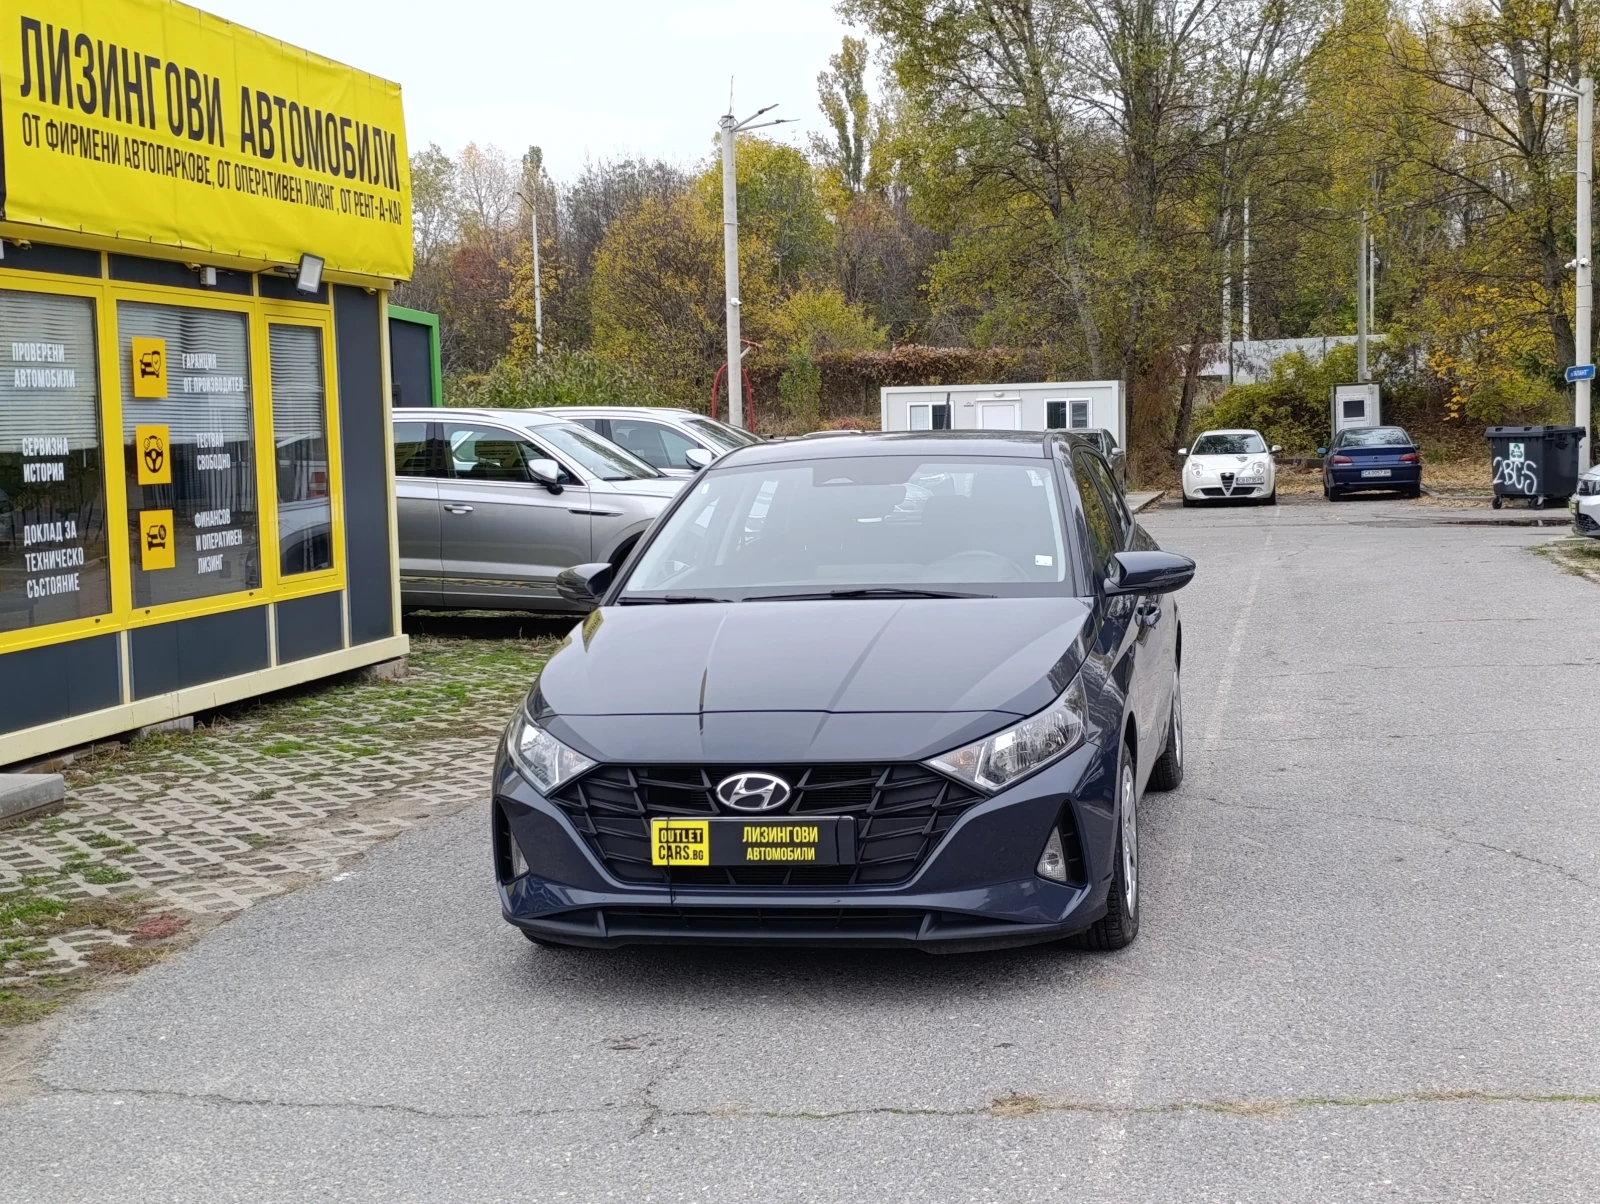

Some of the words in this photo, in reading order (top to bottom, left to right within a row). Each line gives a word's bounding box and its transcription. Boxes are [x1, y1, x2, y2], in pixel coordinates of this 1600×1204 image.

[20, 15, 225, 148] ЛИЗИНГОВИ
[240, 86, 401, 192] АВТОМОБИЛИ
[22, 112, 41, 149] ОТ
[45, 118, 121, 165] ФИРМЕНИ
[124, 136, 215, 190] АВТОПАРКОВЕ,
[217, 159, 231, 190] ОТ
[234, 163, 303, 205] ОПЕРАТИВЕН
[340, 188, 352, 215] ОТ
[12, 342, 65, 362] ПРОВЕРЕНИ
[182, 353, 217, 370] ГАРАНЦИЯ
[14, 368, 76, 388] АВТОМОБИЛИ
[184, 377, 193, 392] ОТ
[22, 437, 69, 456] СЕРВИЗНА
[196, 430, 224, 448] ТЕСТВАЙ
[23, 462, 65, 482] ИСТОРИЯ
[197, 453, 231, 471] СВОБОДНО
[194, 508, 231, 528] ФИНАНСОВ
[24, 522, 63, 546] ДОКЛАД
[65, 520, 77, 539] ЗА
[195, 535, 202, 551] И
[202, 529, 243, 551] ОПЕРАТИВЕН
[25, 547, 84, 572] ТЕХНИЧЕСКО
[198, 554, 224, 574] ЛИЗИНГ
[27, 572, 80, 599] СЪСТОЯНИЕ
[660, 829, 703, 843] OUTLET
[742, 826, 819, 843] ЛИЗИНГОВИ
[658, 844, 704, 861] CARS.BG
[746, 847, 816, 861] АВТОМОБИЛИ
